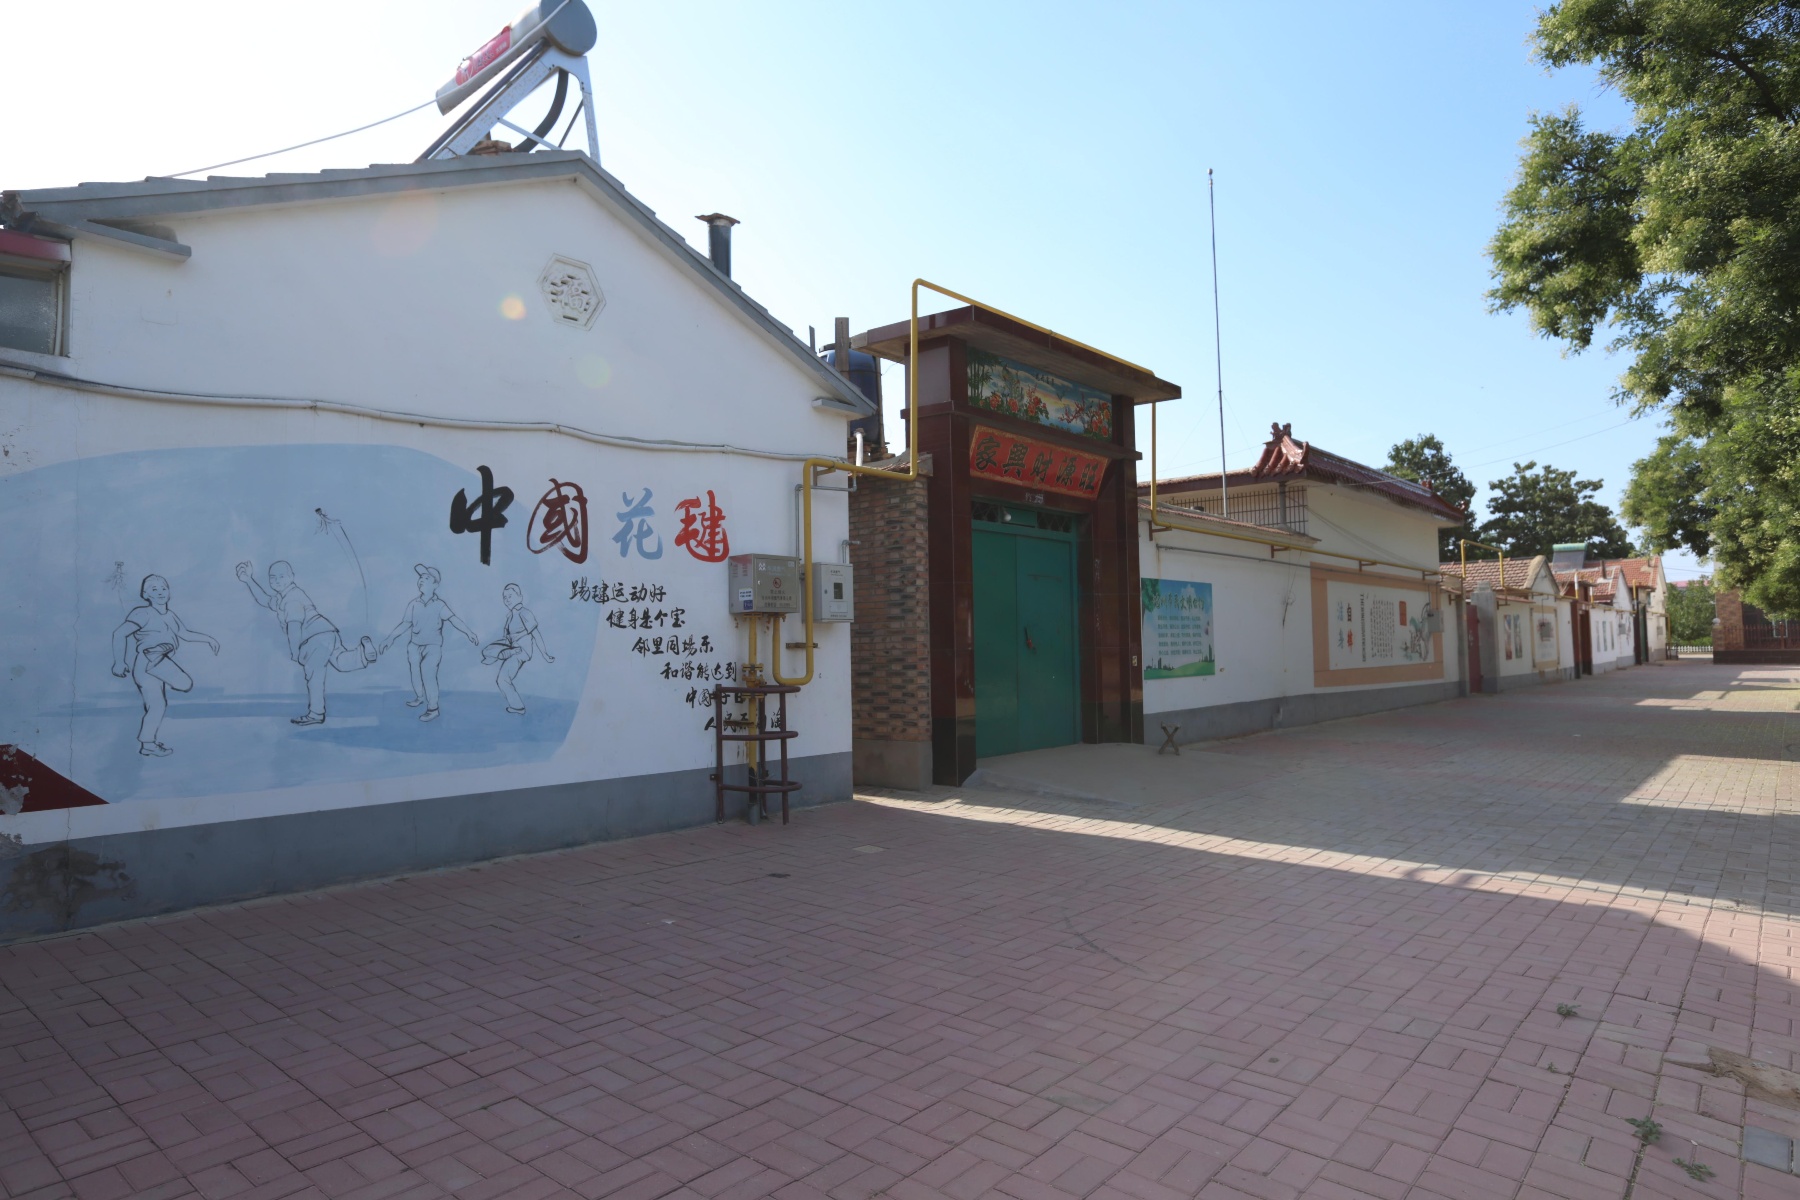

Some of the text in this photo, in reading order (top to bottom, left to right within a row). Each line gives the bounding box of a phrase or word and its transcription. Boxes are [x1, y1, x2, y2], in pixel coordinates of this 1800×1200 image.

[606, 607, 686, 629] 健身是个宝
[660, 661, 737, 682] 和谐能达到
